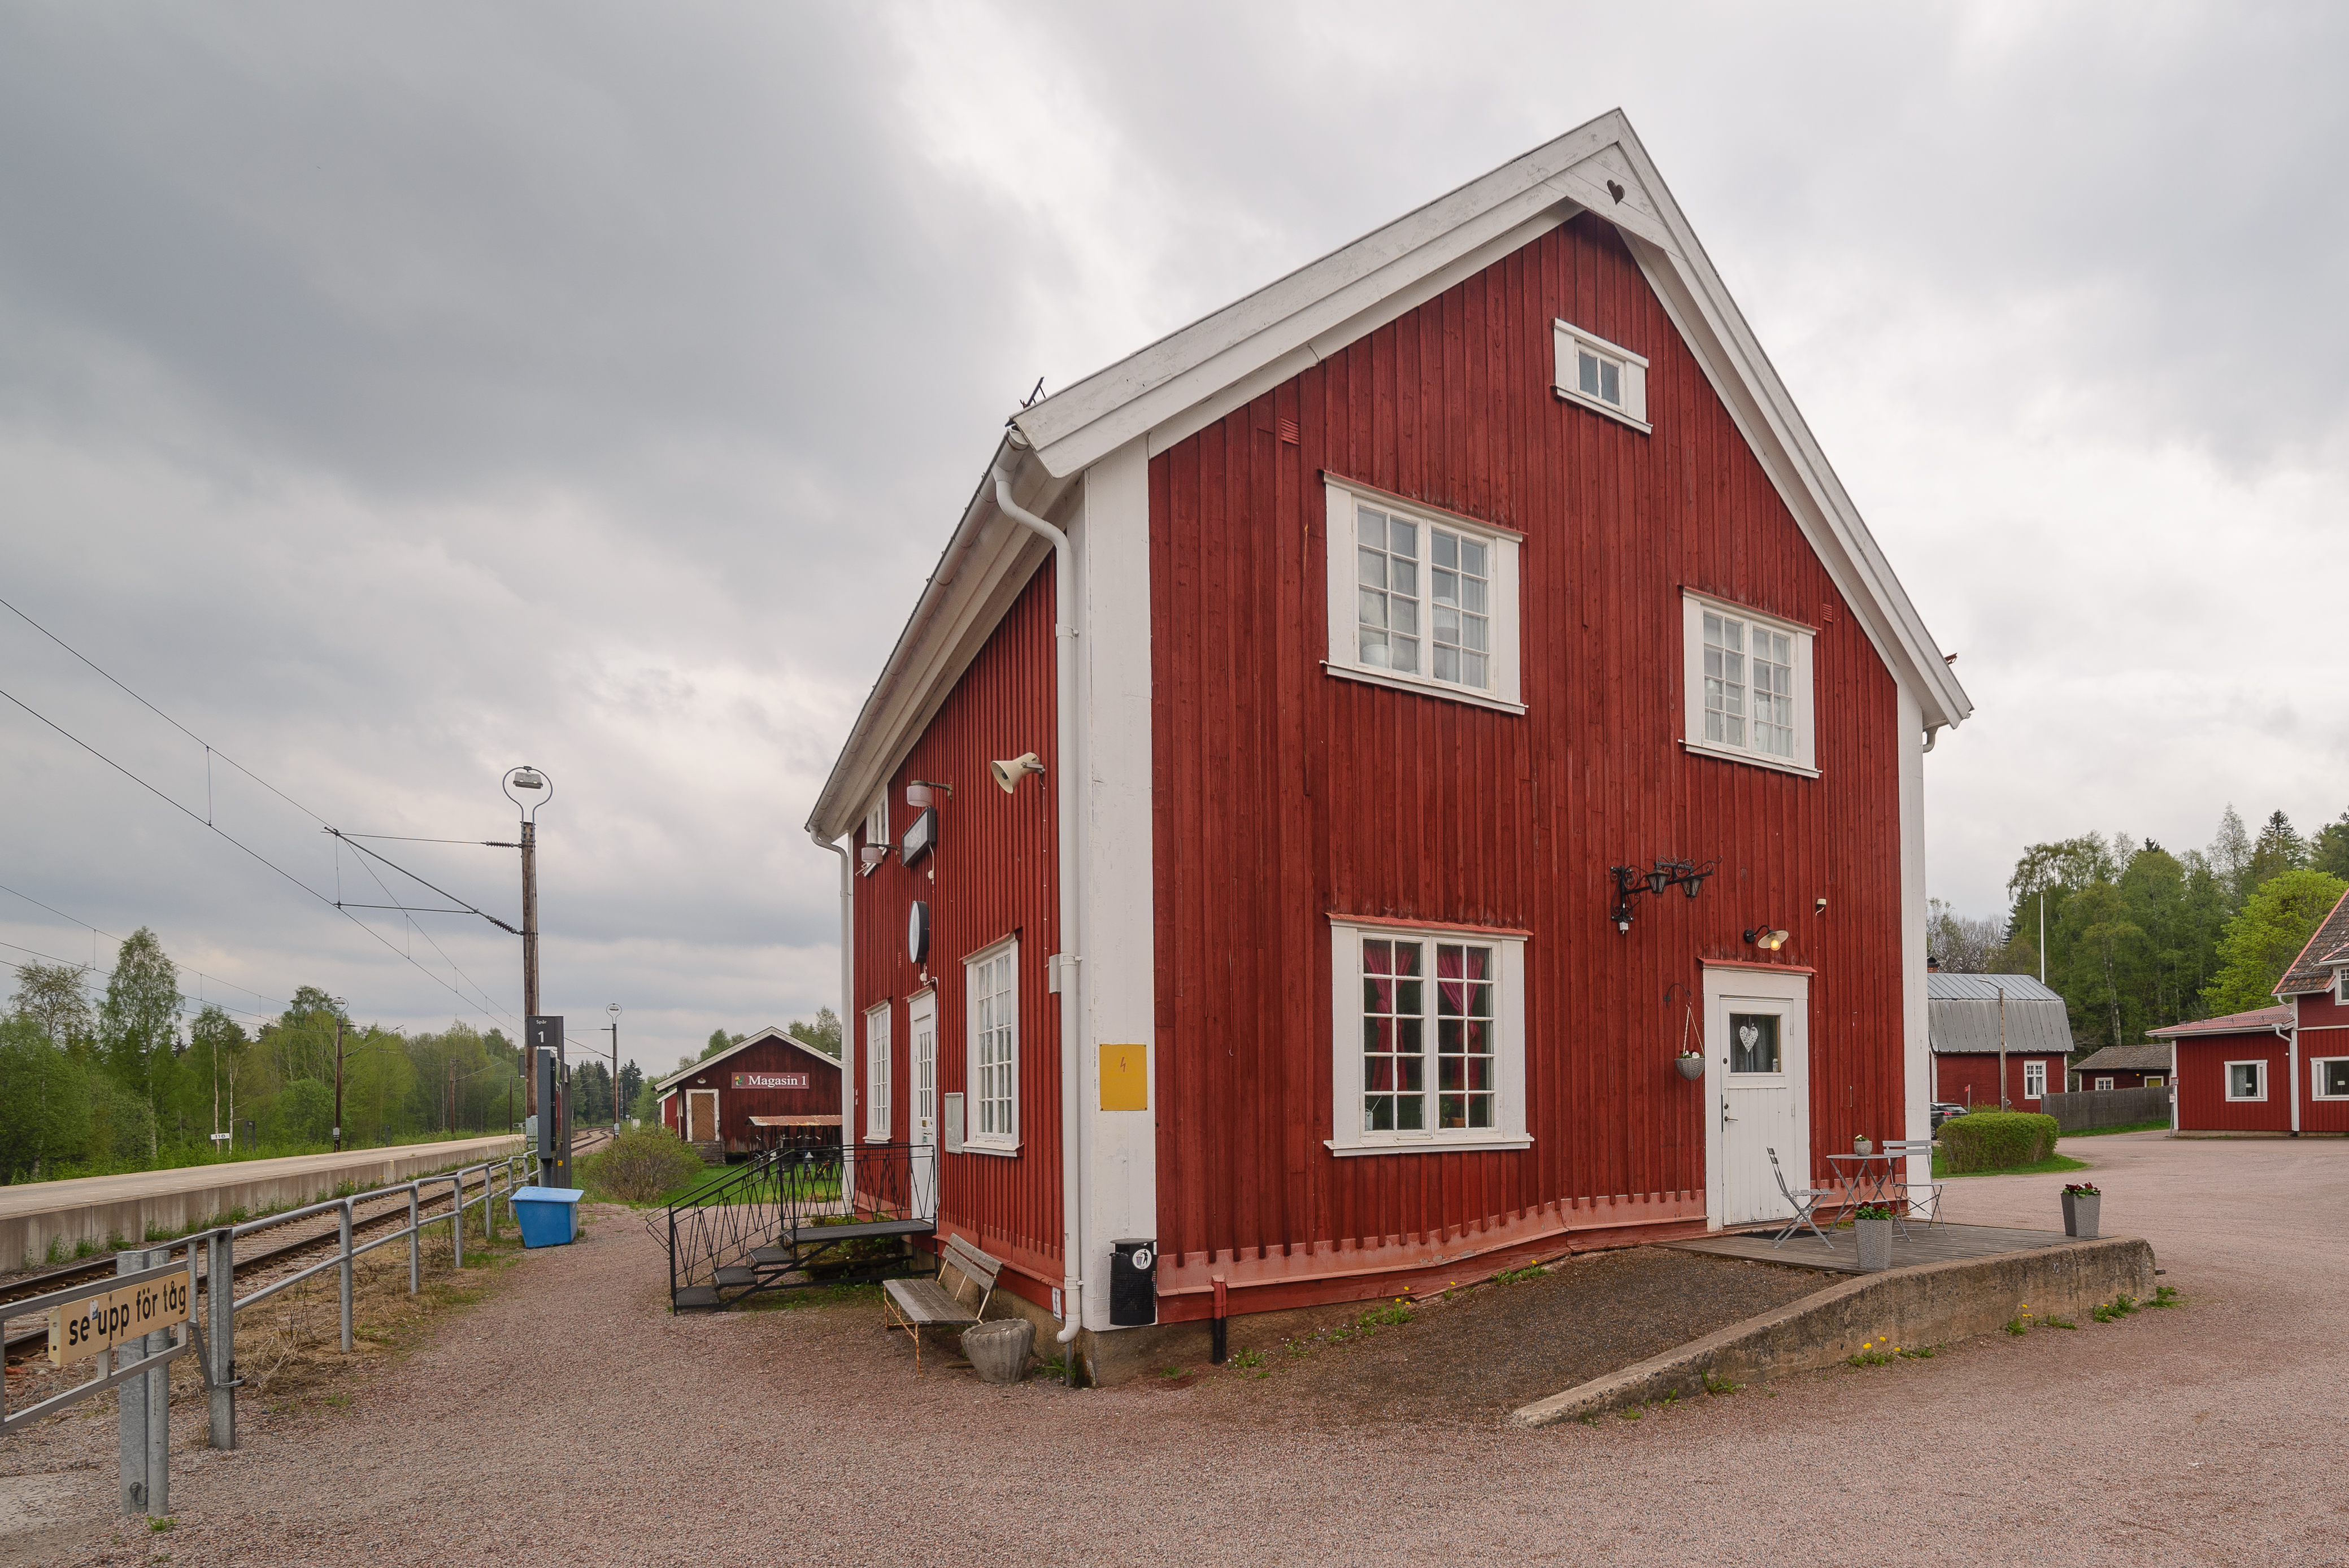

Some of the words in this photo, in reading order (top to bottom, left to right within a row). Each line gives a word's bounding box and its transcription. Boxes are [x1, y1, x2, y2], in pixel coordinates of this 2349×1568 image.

[538, 1031, 544, 1043] 1
[748, 1075, 798, 1088] Magasin
[802, 1075, 806, 1086] 1
[69, 1316, 90, 1346] se
[98, 1303, 130, 1341] upp
[136, 1287, 158, 1323] för
[163, 1280, 186, 1315] tåg
